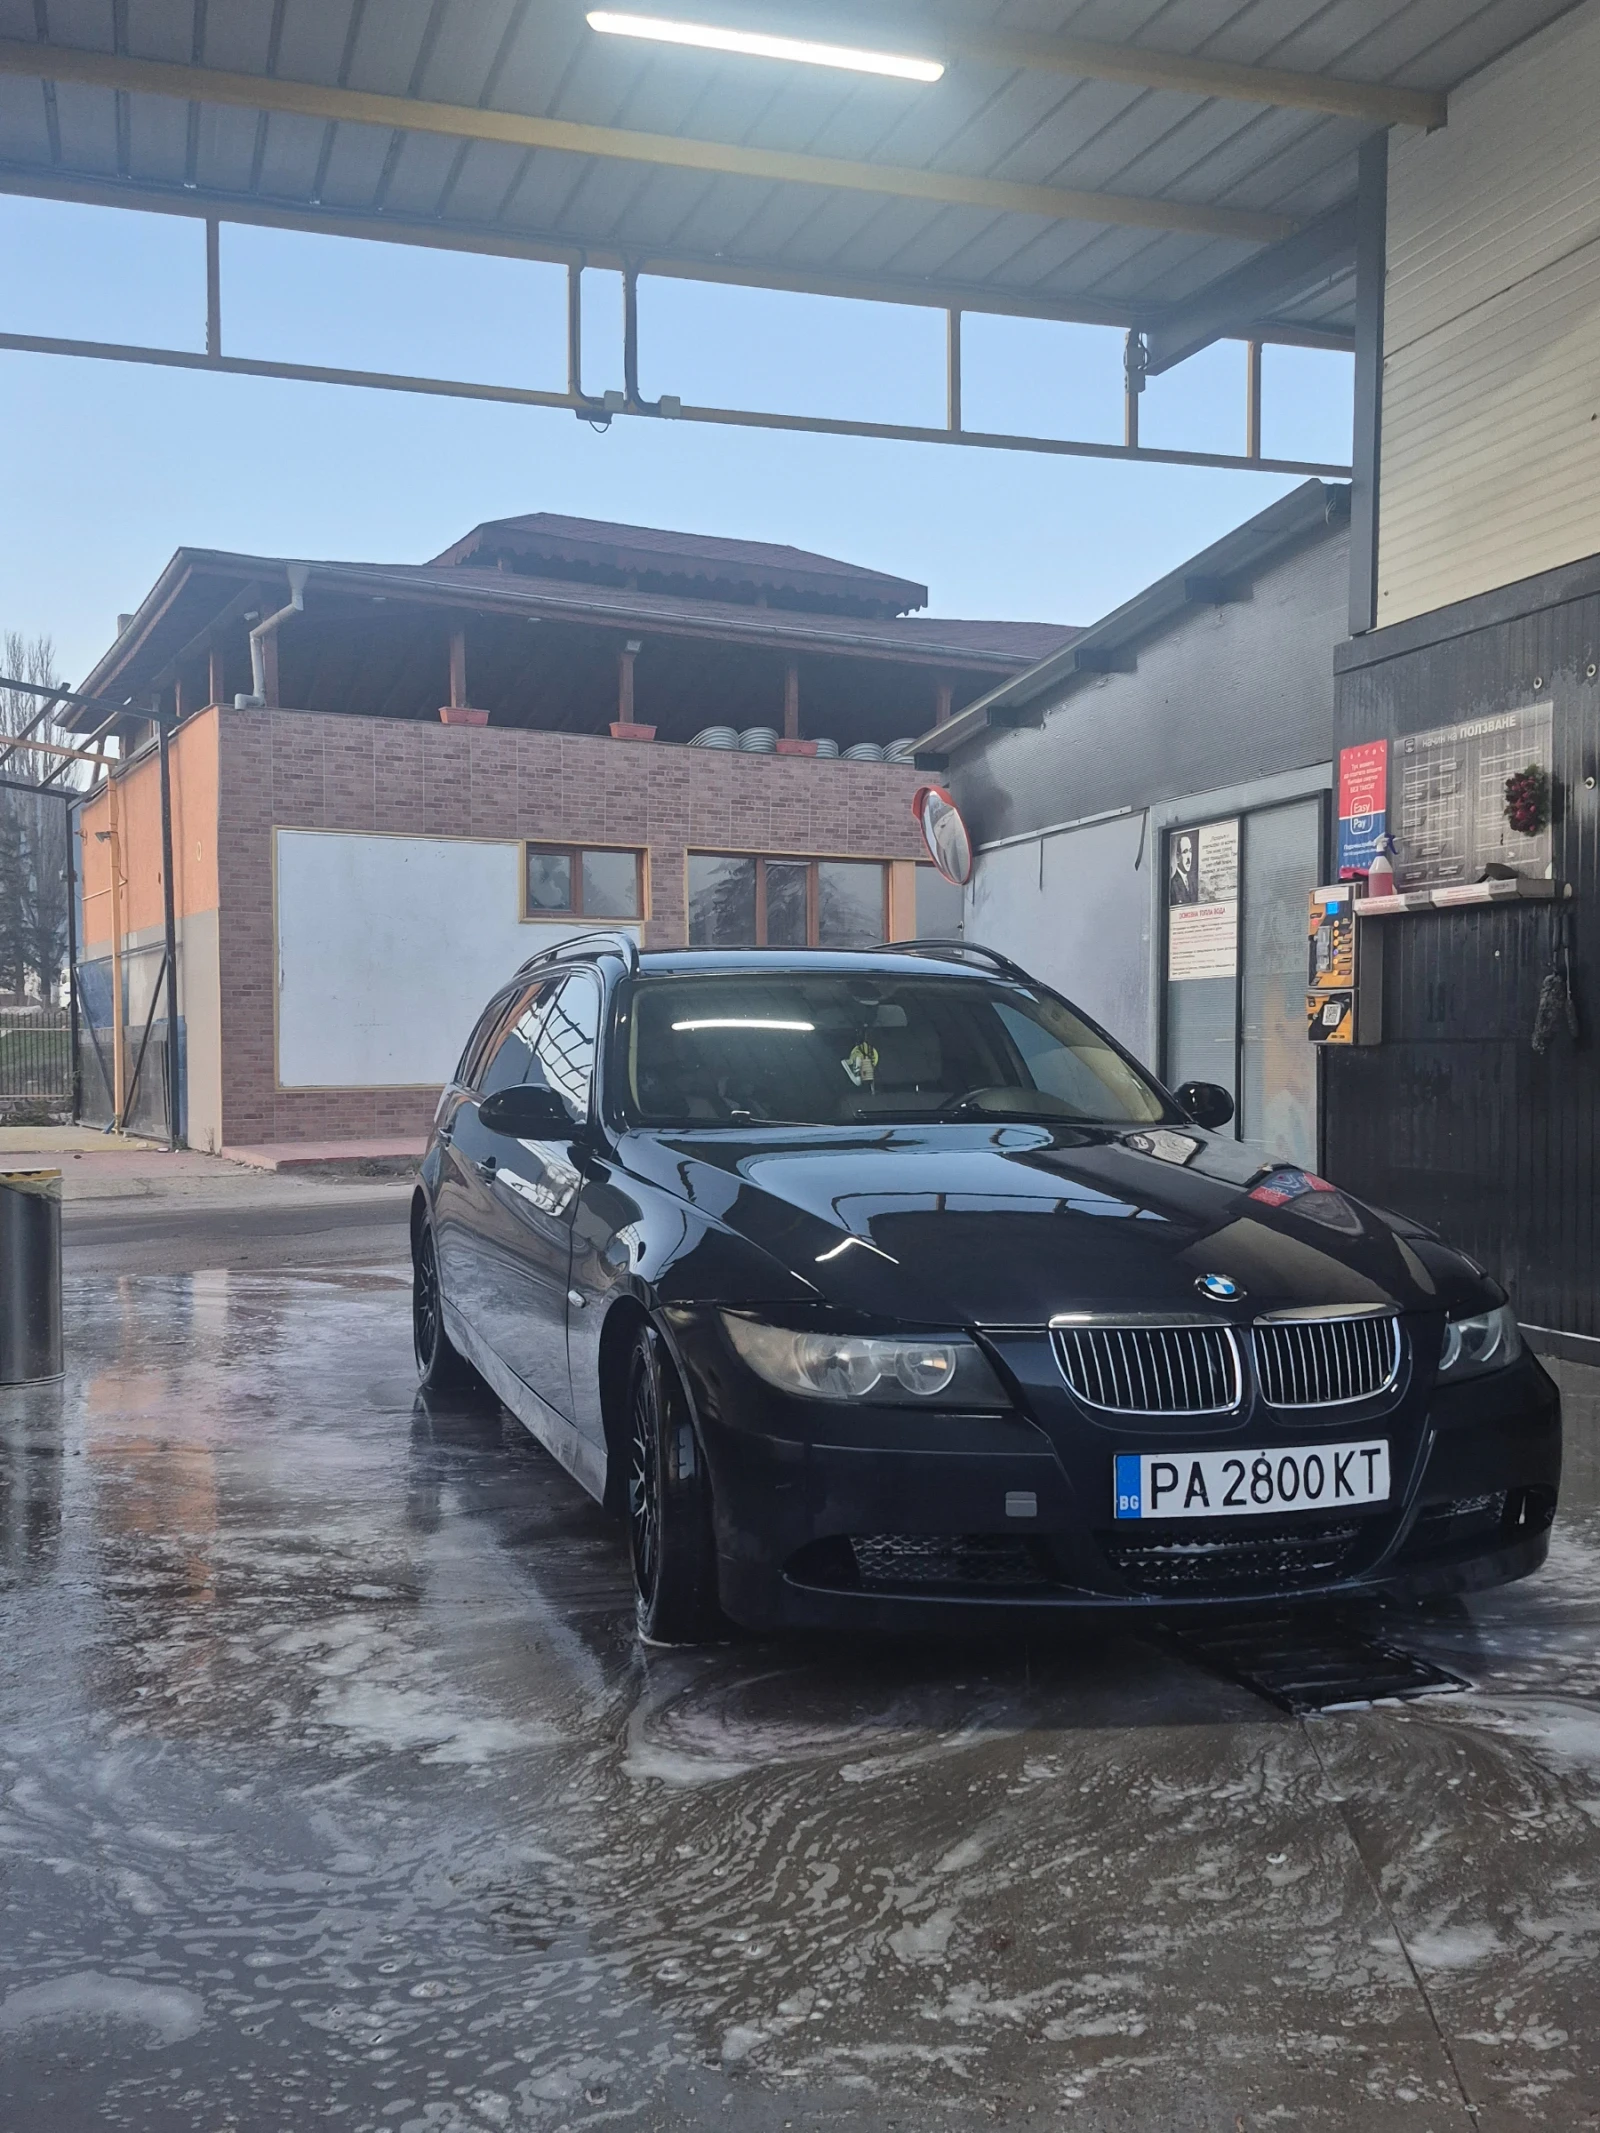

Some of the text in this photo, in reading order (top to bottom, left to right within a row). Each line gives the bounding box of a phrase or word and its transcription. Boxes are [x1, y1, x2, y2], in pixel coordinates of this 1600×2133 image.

[1422, 714, 1517, 748] начин на ПОЛЗВАНЕ
[1353, 802, 1371, 815] Easy
[1353, 818, 1367, 830] Pay
[1119, 1494, 1140, 1511] BG
